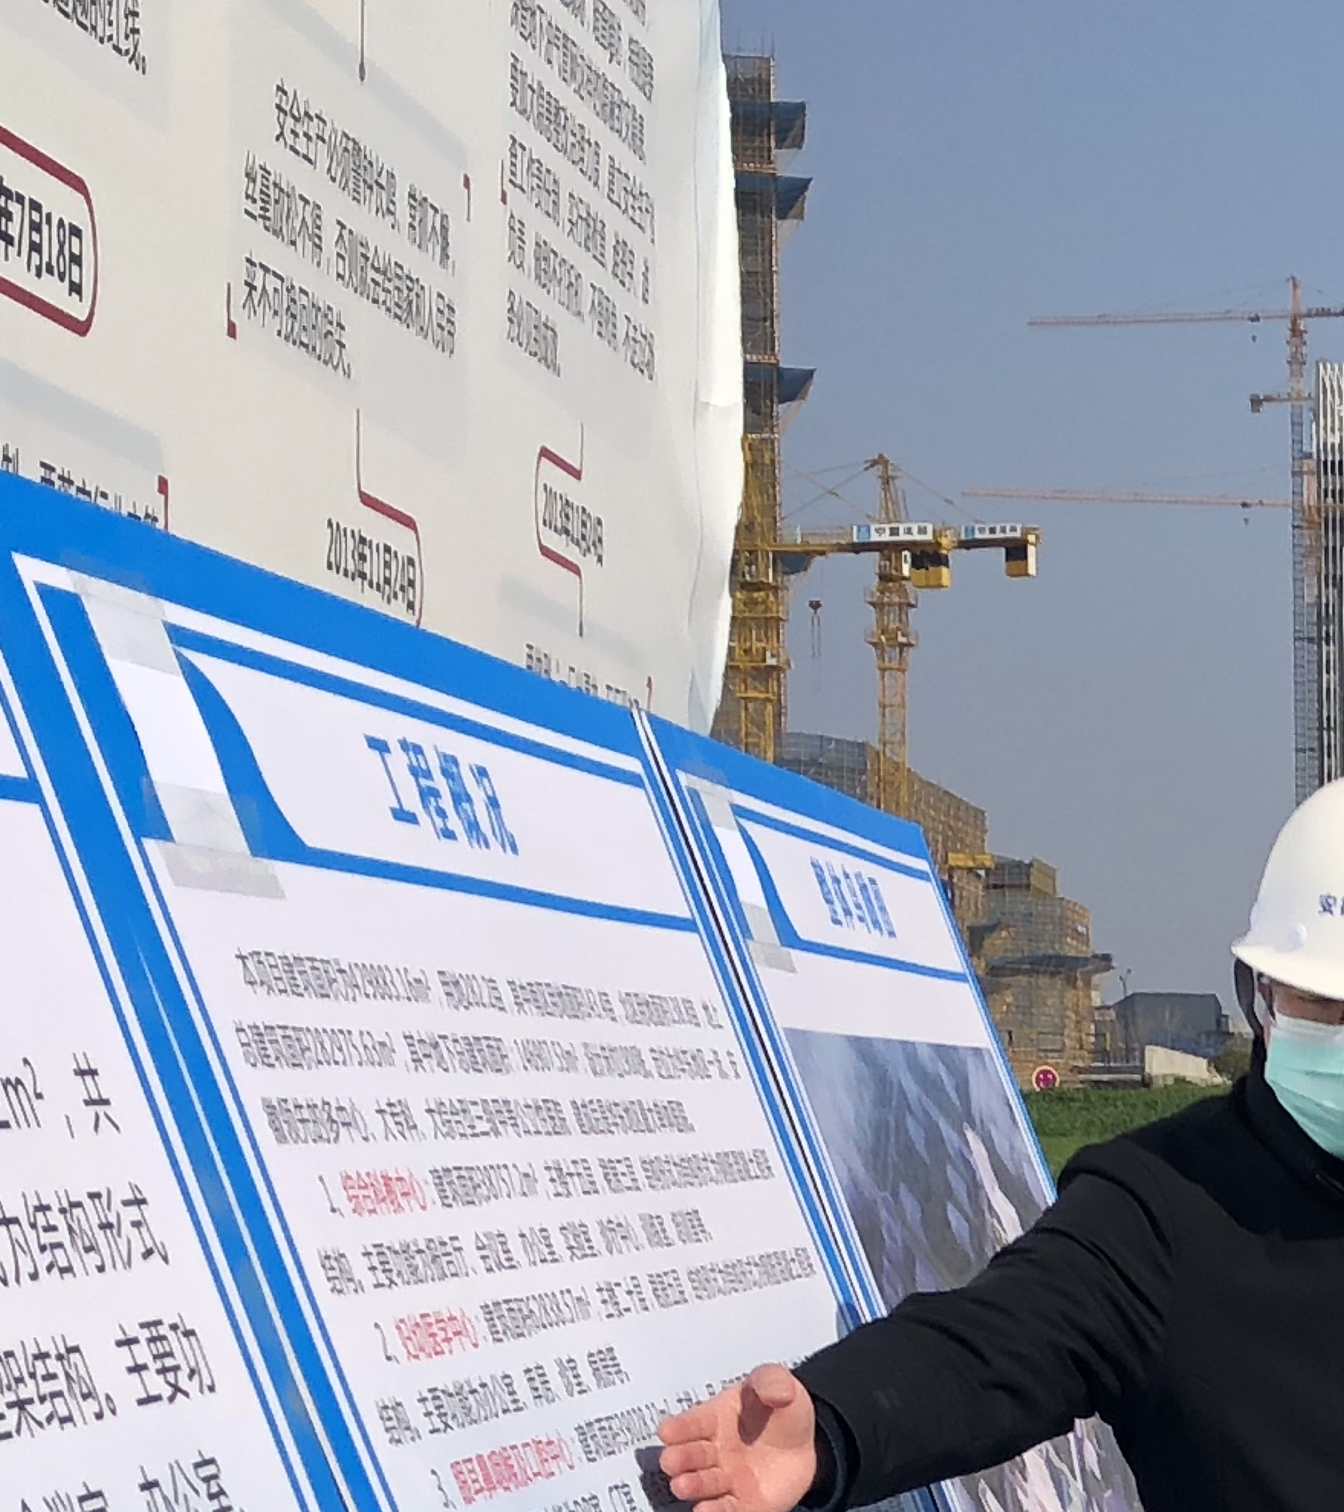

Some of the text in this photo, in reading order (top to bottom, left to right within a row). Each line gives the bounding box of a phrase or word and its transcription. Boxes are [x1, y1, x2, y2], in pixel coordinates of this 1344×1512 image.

[325, 516, 417, 616] 2013年11月24日
[364, 733, 519, 855] 工程概况
[0, 1052, 120, 1139] m²，共
[0, 1181, 169, 1287] 为结构形式
[0, 1313, 216, 1441] 架结构。主要功
